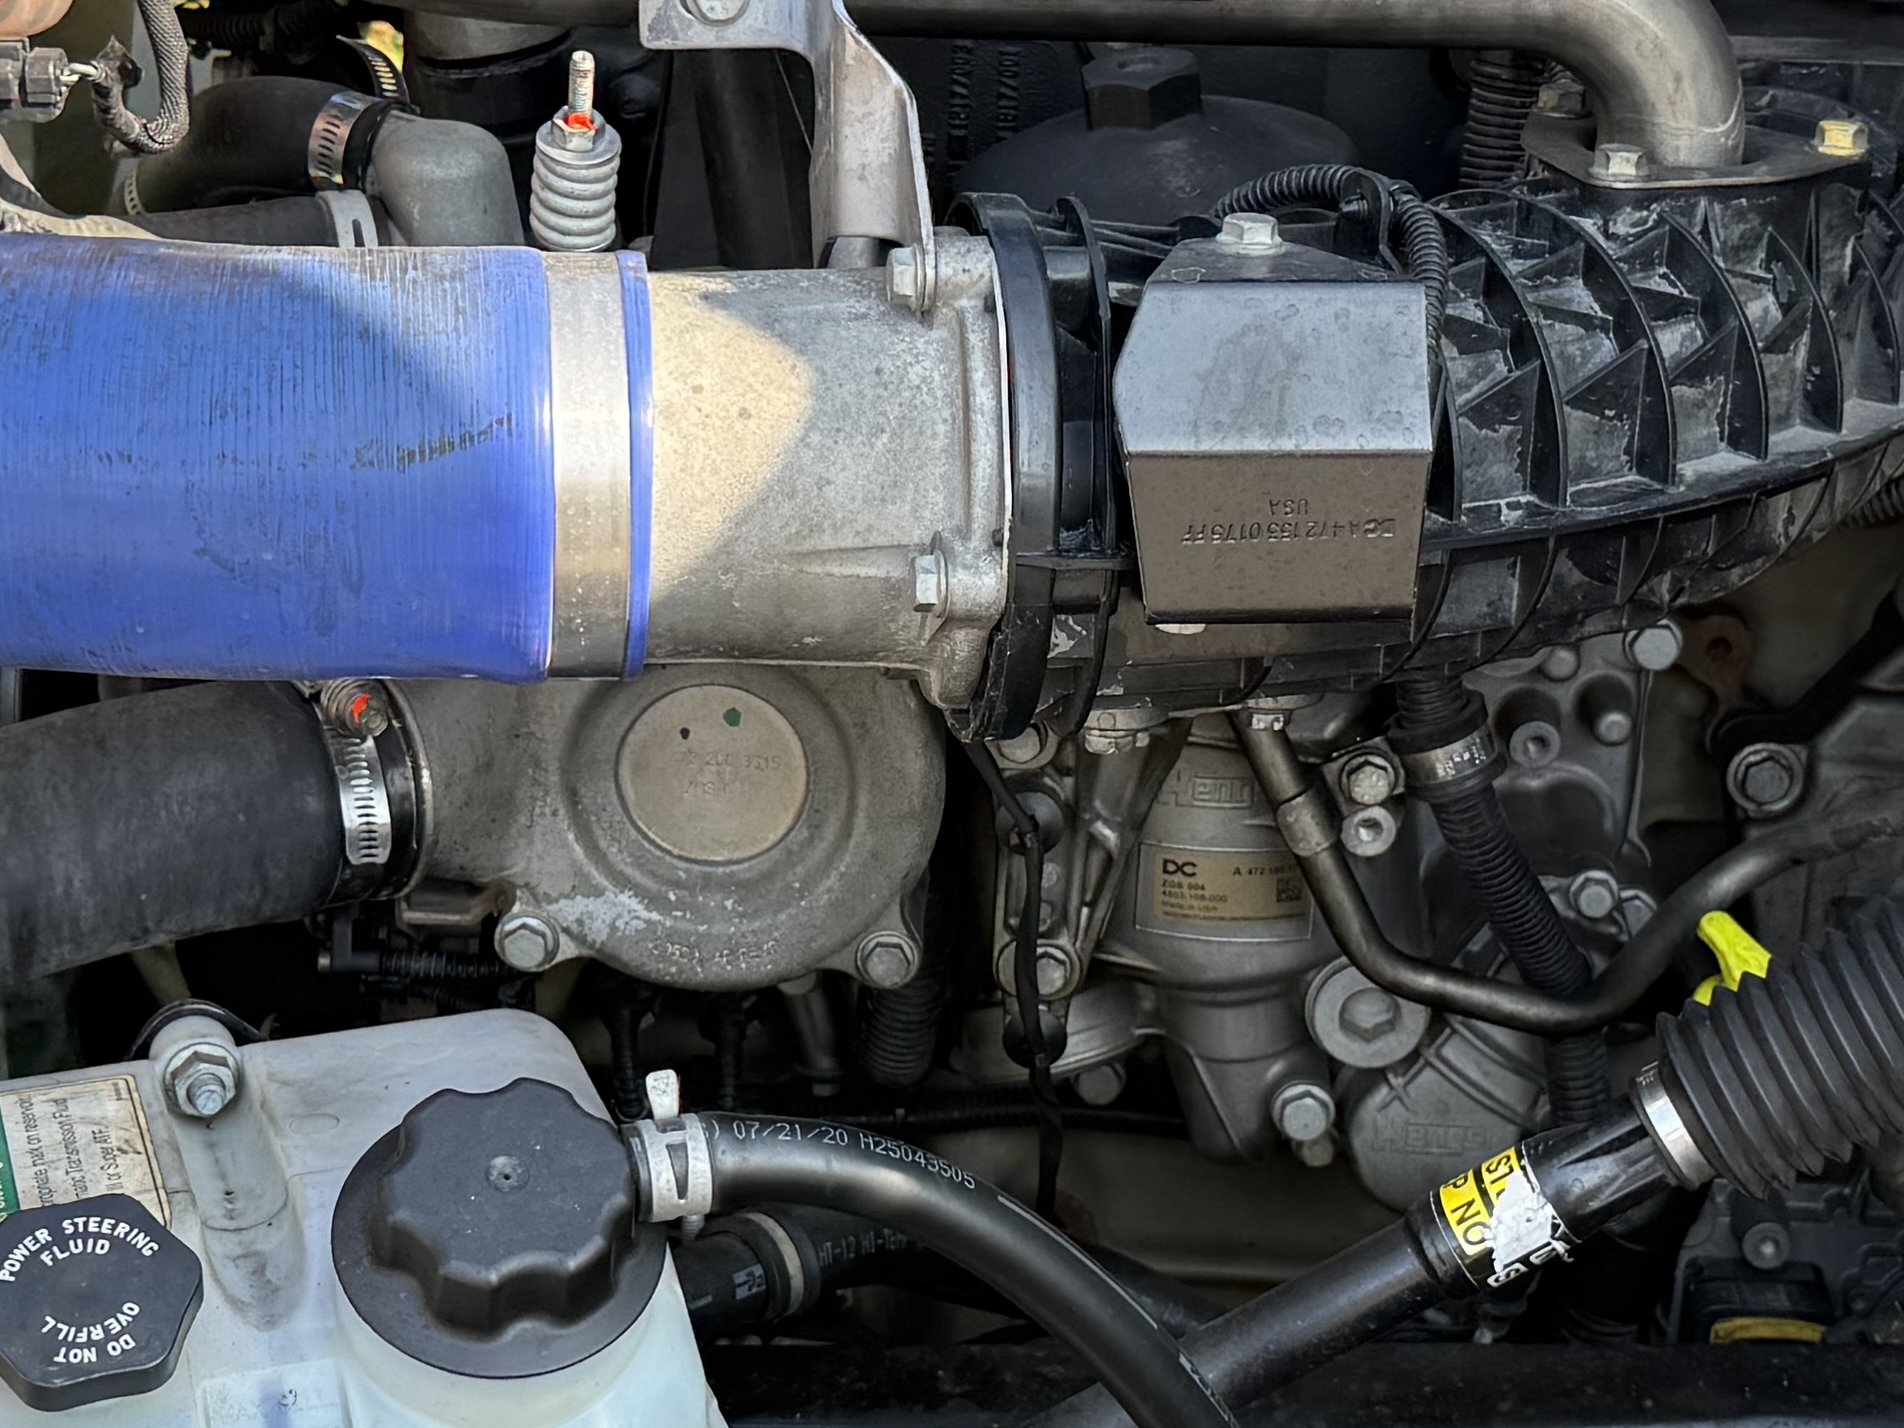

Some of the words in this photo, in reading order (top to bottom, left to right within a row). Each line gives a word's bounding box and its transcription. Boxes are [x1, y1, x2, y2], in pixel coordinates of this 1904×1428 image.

[1268, 498, 1308, 517] USA
[1162, 858, 1197, 877] DC
[1232, 867, 1242, 876] A
[52, 1098, 70, 1119] Fluid
[733, 1122, 848, 1146] 07/21/20
[62, 1217, 160, 1257] STEERING
[40, 1238, 110, 1266] FLUID
[41, 1302, 140, 1342] OVERFILL
[53, 1347, 97, 1363] NOT
[107, 1334, 136, 1356] DO
